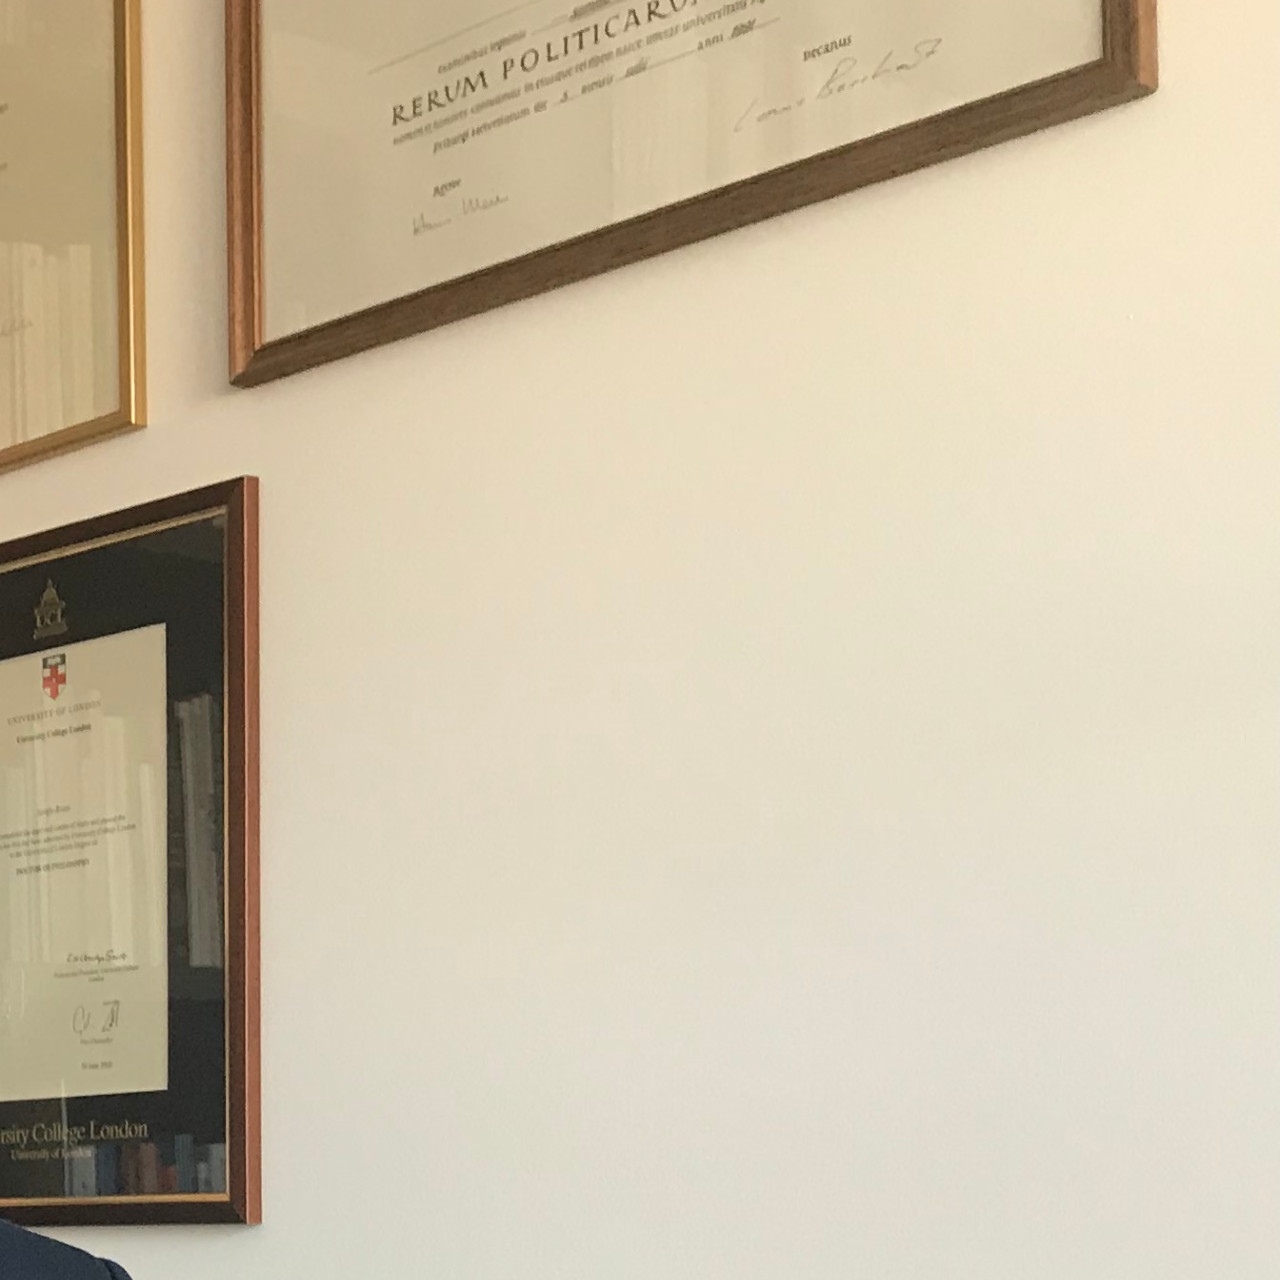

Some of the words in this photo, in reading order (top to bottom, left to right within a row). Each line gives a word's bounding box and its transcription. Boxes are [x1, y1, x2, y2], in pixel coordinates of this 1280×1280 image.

[391, 71, 490, 127] RERUM
[502, 0, 700, 82] POLITICARU
[31, 1122, 86, 1146] College
[89, 1119, 149, 1140] London
[10, 1149, 51, 1162] University
